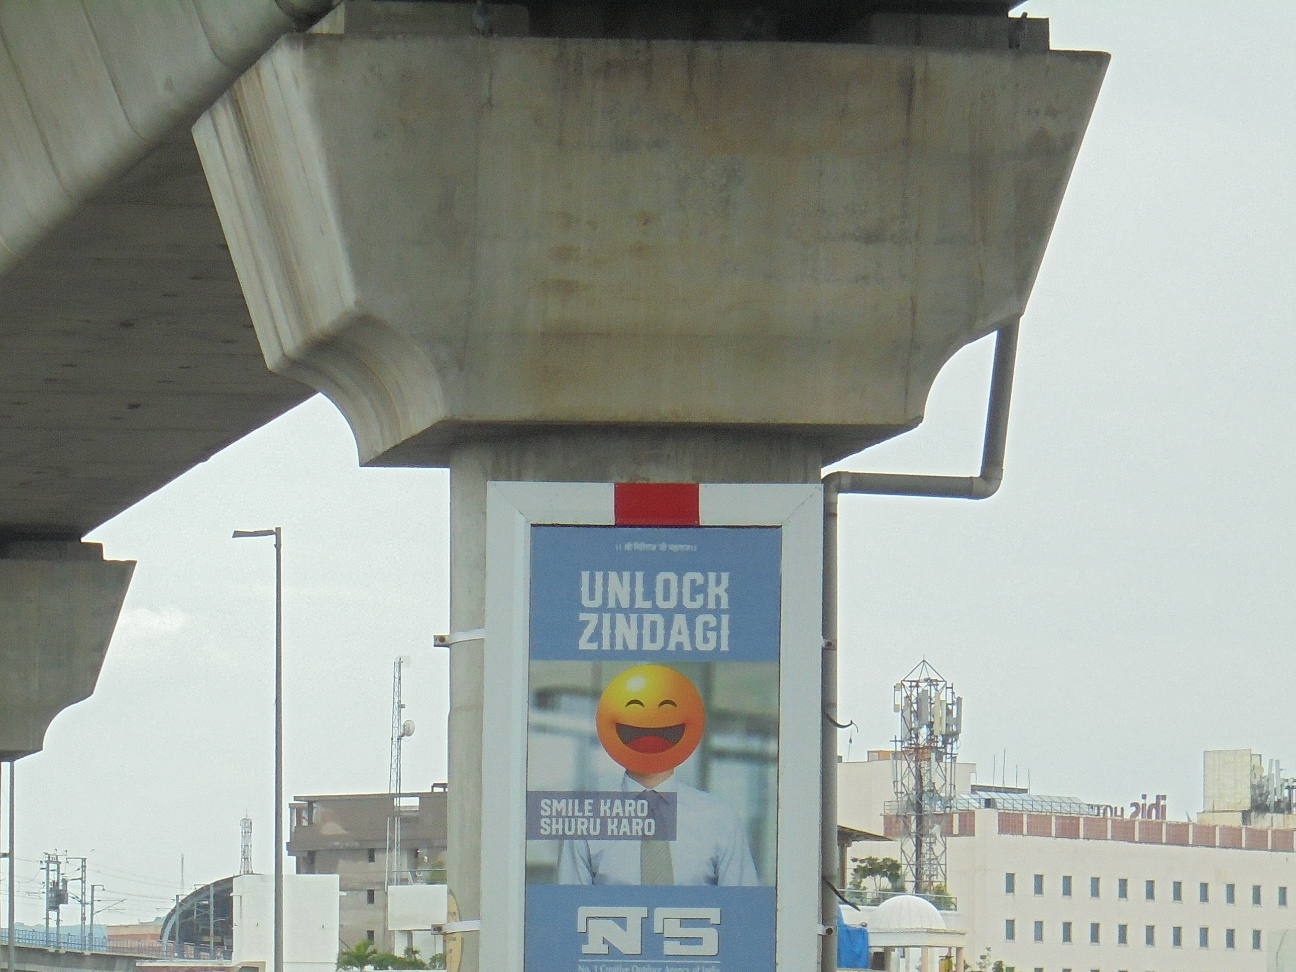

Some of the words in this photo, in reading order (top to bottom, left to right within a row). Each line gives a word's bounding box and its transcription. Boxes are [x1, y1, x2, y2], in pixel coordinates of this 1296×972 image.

[579, 571, 731, 609] UNLOCK
[578, 612, 731, 652] ZINDAGI
[540, 798, 594, 817] SMILE
[600, 798, 648, 818] KARO
[540, 818, 601, 836] SHURU
[607, 818, 656, 837] KARO
[577, 906, 722, 956] NS
